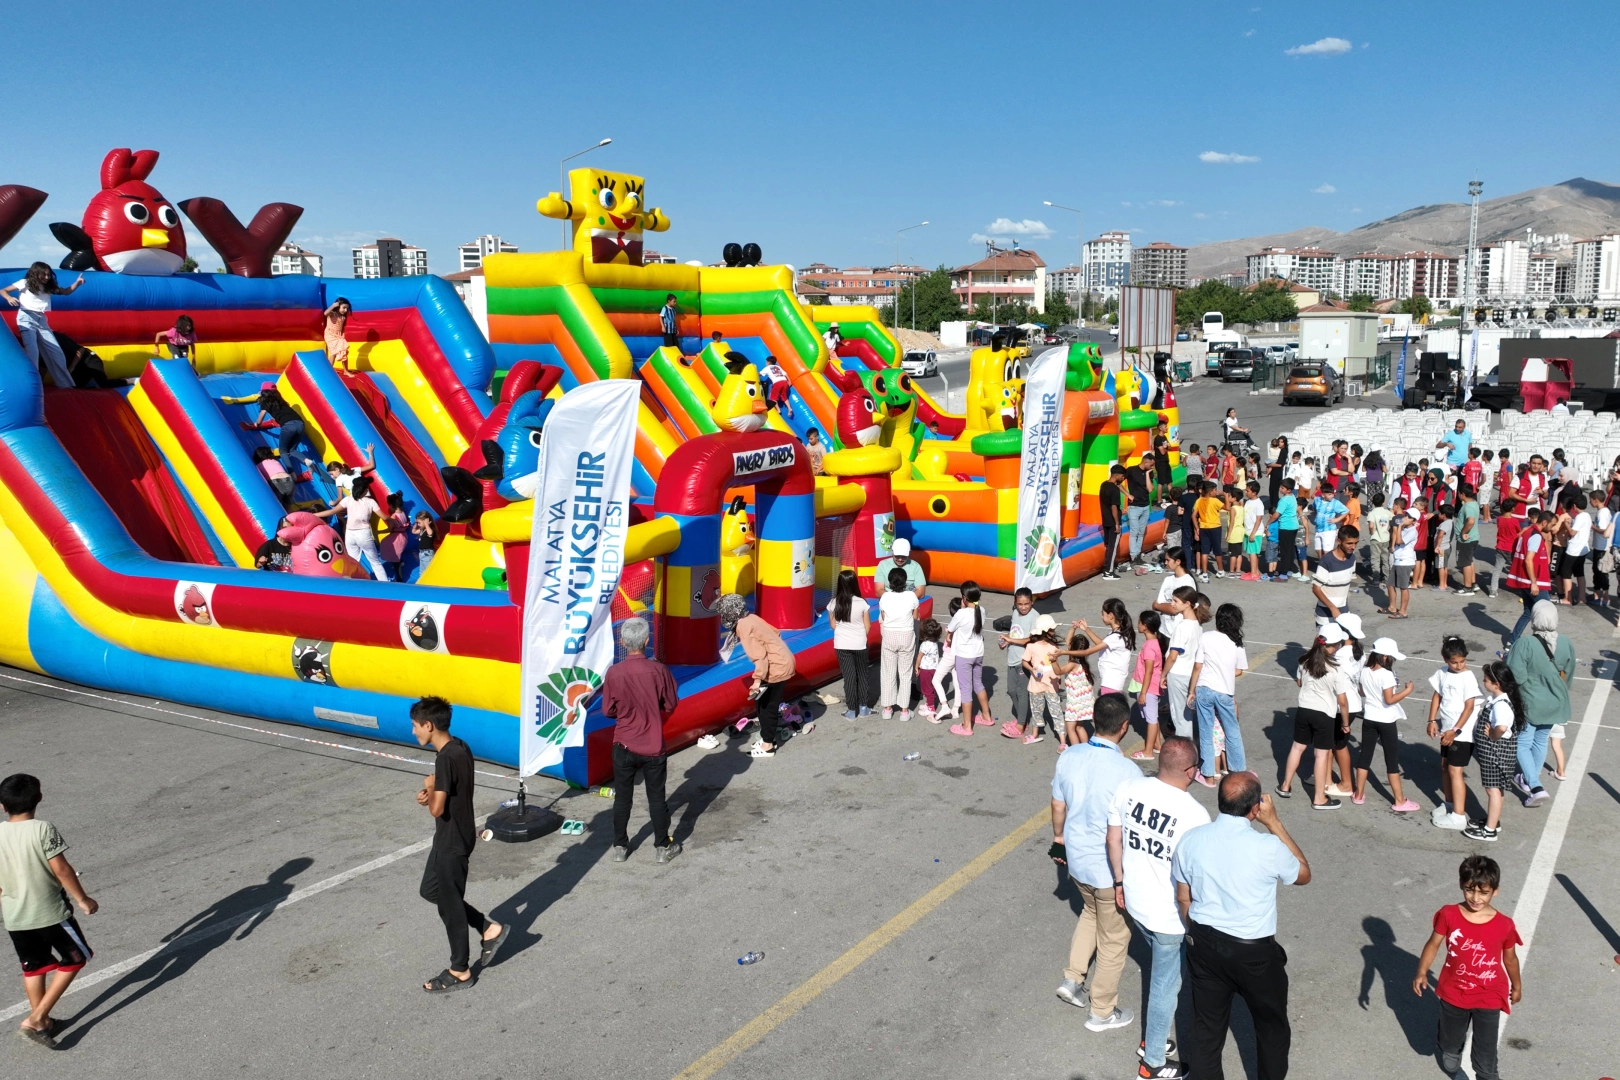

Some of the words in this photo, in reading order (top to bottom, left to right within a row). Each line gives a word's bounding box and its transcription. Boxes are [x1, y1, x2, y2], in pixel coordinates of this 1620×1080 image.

[736, 451, 766, 474] ANGRY
[768, 445, 794, 466] BIRDS
[1026, 423, 1039, 488] MALATYA
[542, 499, 567, 604] MALATYA
[563, 451, 606, 655] BÜYÜKŞEHİR
[599, 500, 623, 605] BELEDİYESİ
[1128, 829, 1164, 860] 5.12
[1131, 801, 1171, 834] 4.87
